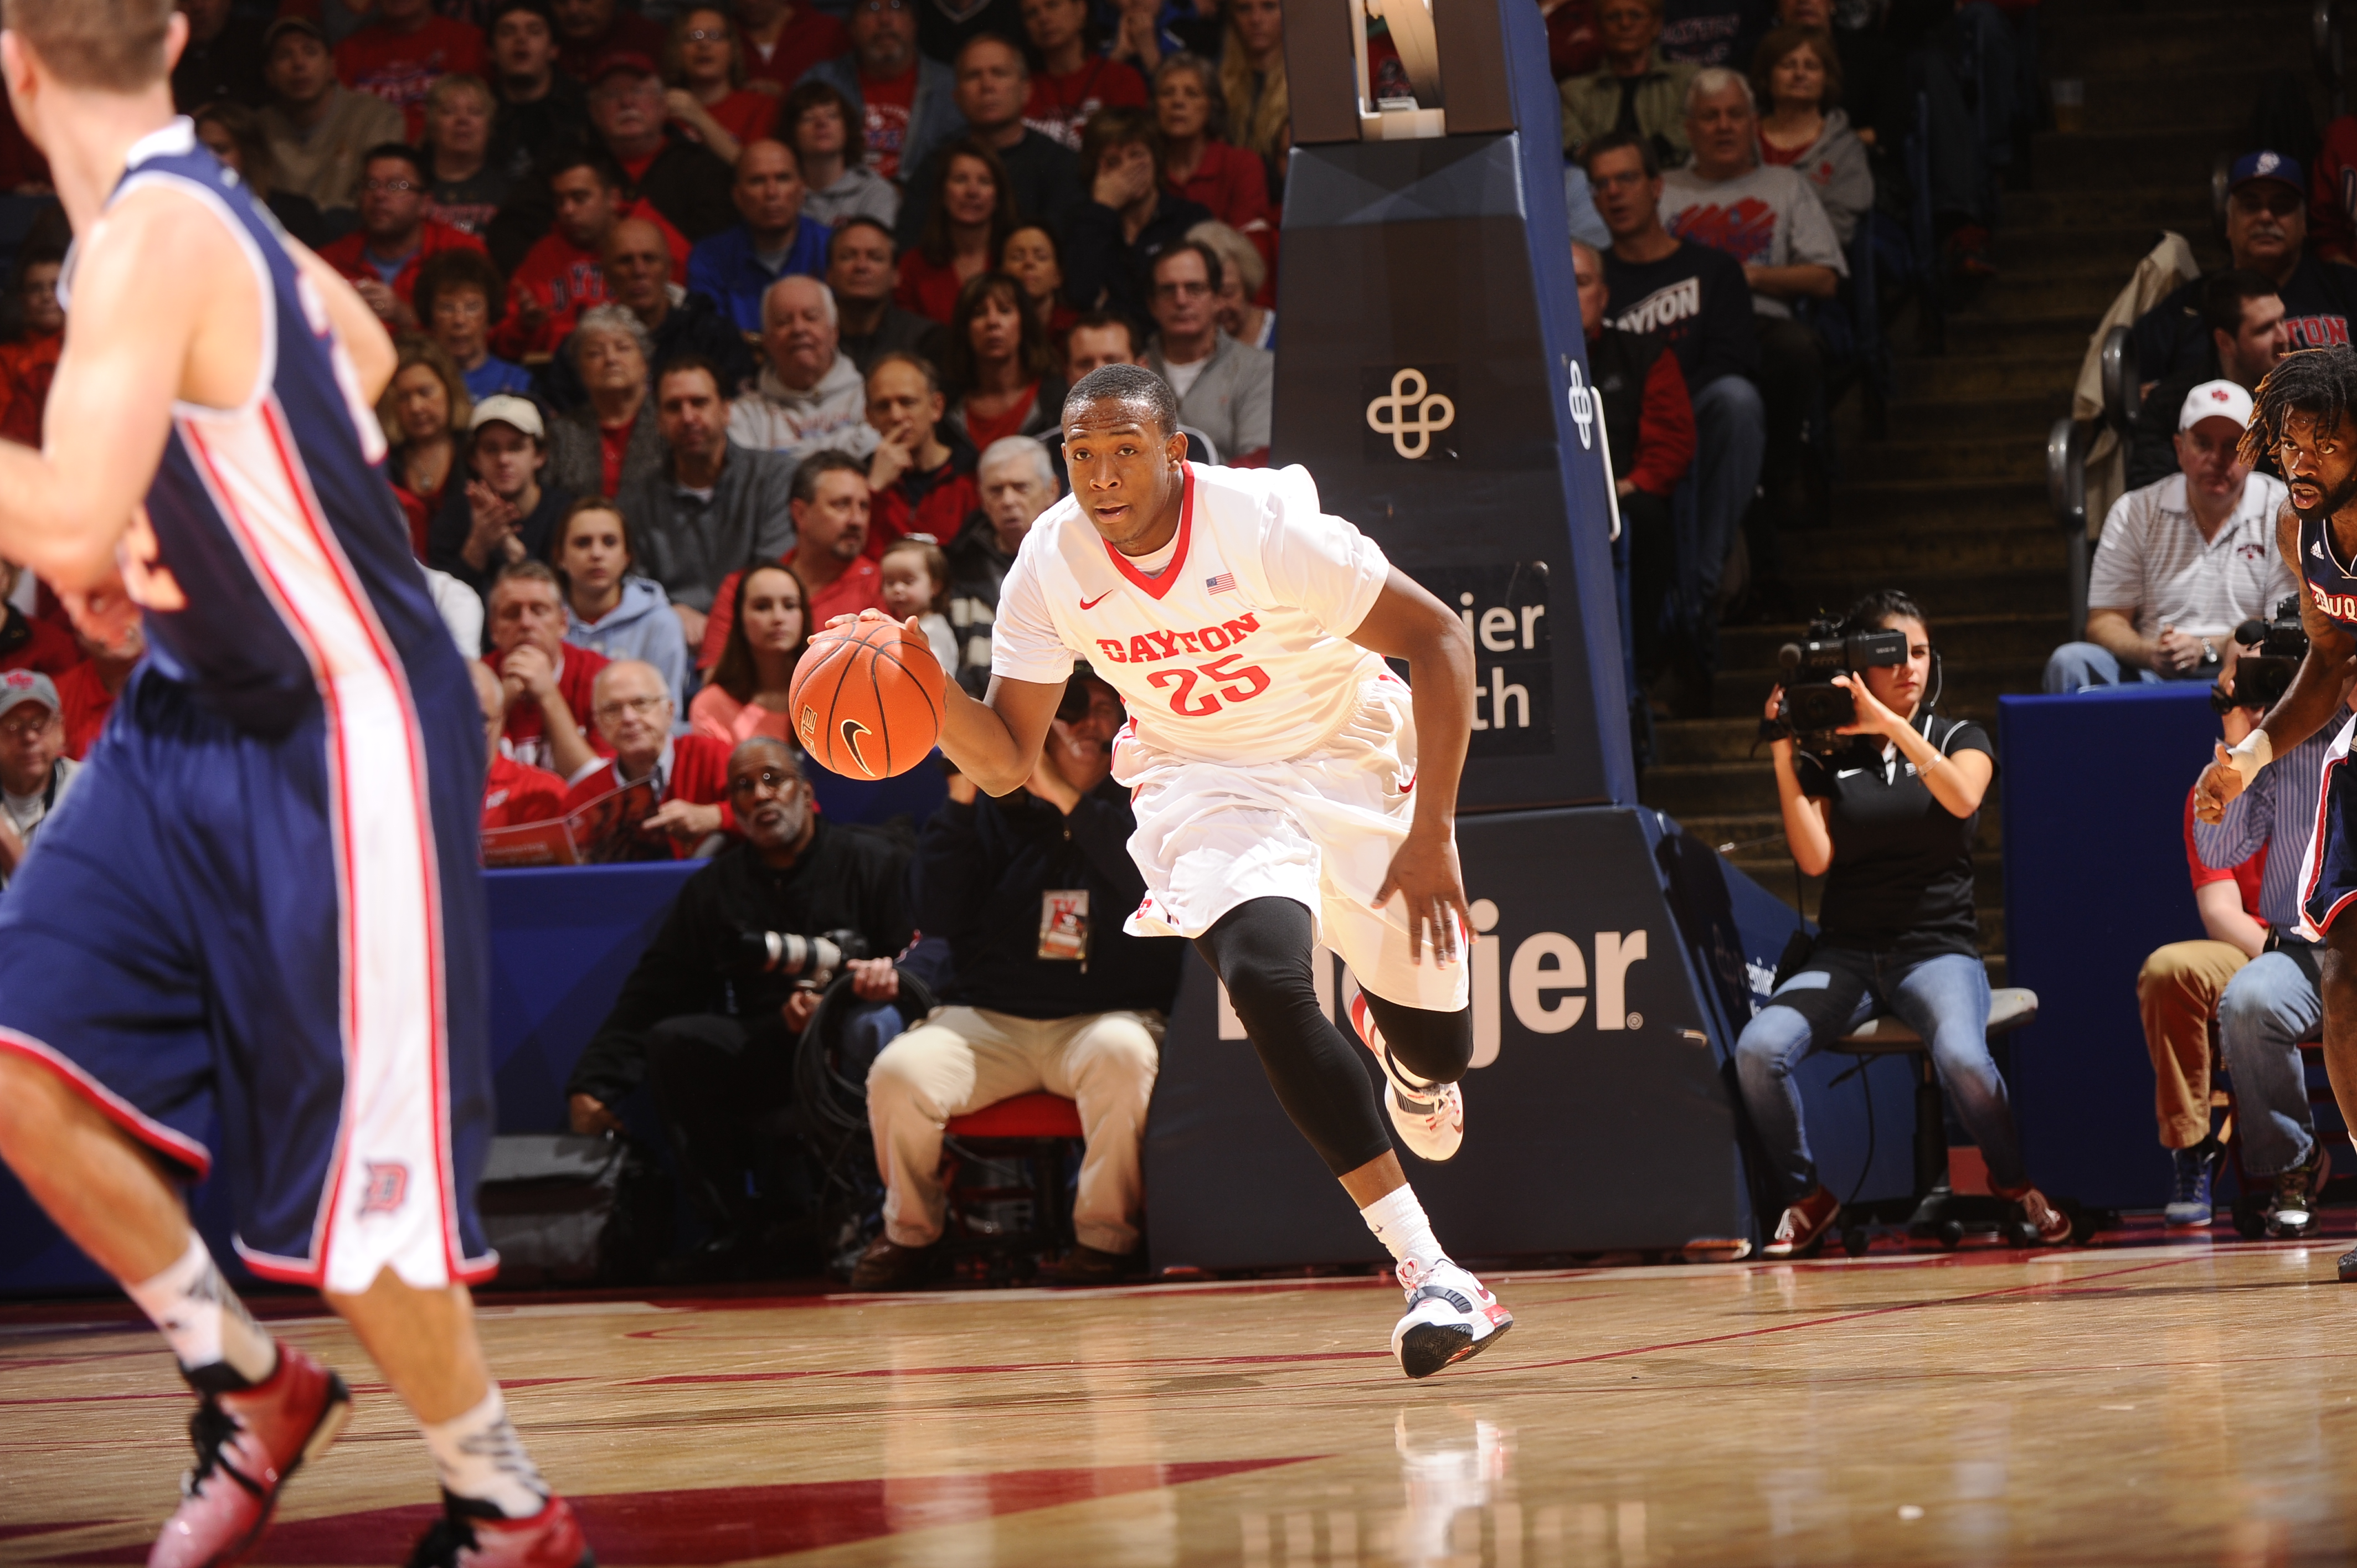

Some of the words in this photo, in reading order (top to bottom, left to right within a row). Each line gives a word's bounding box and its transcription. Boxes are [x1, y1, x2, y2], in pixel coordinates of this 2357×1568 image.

[1096, 612, 1260, 663] DAYTON
[1460, 591, 1545, 652] ier
[1146, 653, 1271, 716] 25
